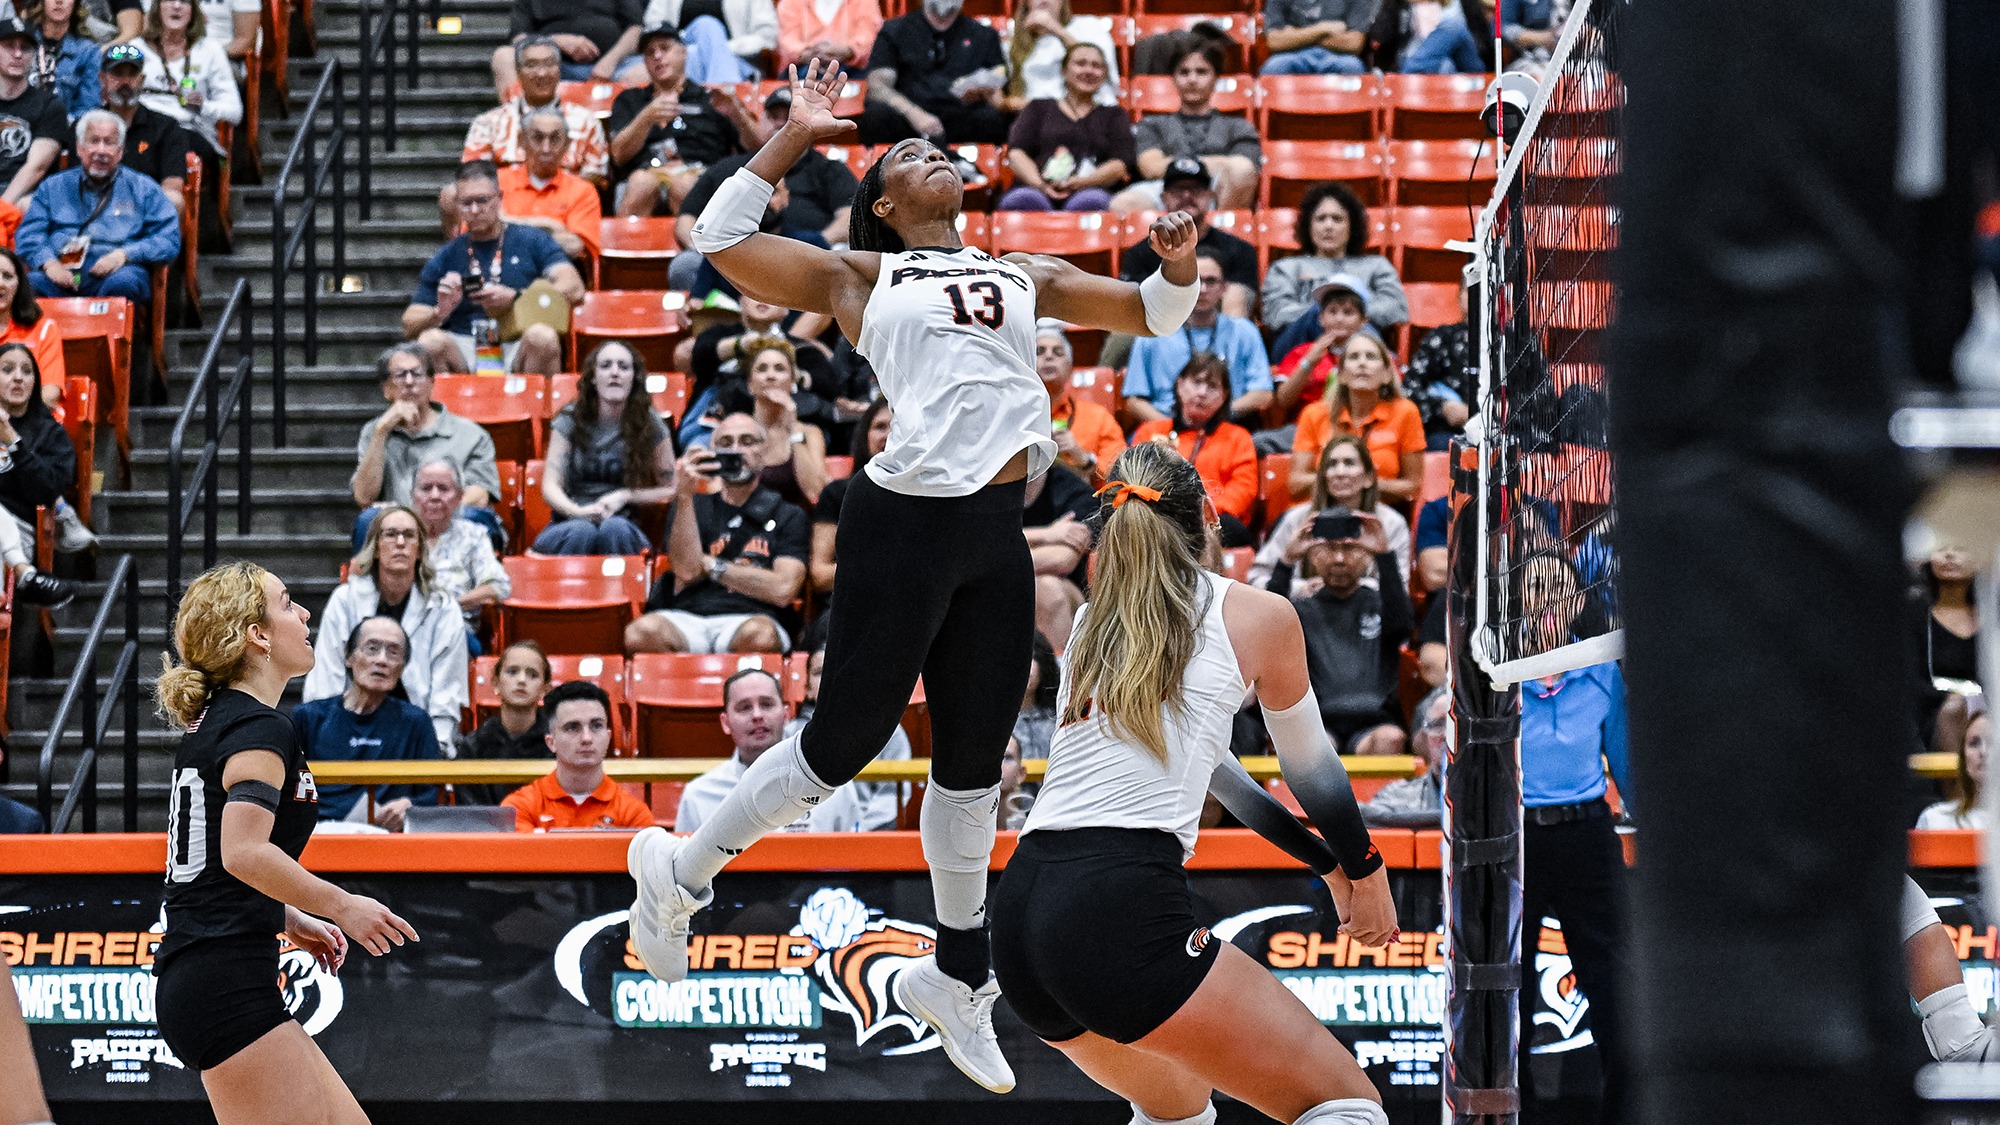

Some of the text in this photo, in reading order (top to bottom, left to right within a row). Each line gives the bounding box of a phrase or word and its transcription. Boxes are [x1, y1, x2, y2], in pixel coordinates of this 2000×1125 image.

[890, 267, 1028, 292] PACIFIC
[943, 281, 1005, 331] 13
[164, 767, 207, 884] 0
[11, 971, 158, 1022] MPETITIO
[616, 975, 813, 1027] COMPETITION
[1281, 974, 1446, 1025] MPETITIO
